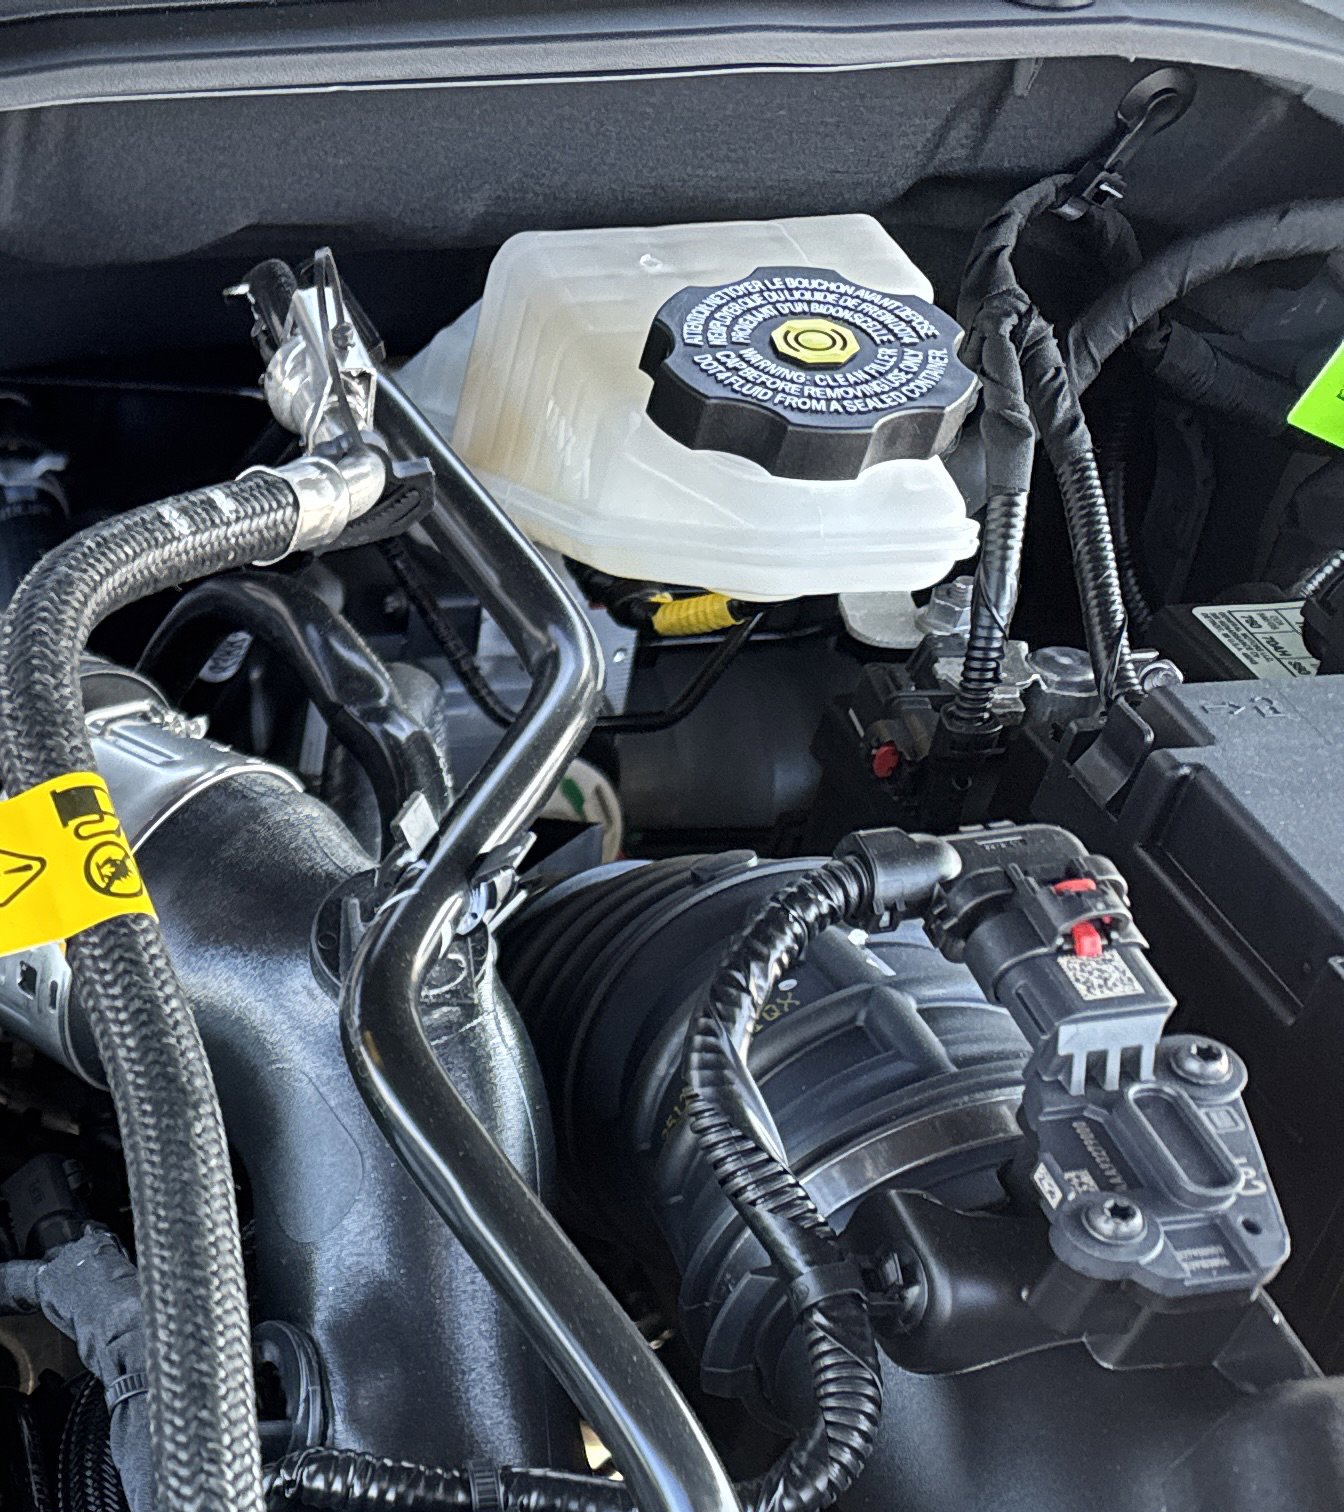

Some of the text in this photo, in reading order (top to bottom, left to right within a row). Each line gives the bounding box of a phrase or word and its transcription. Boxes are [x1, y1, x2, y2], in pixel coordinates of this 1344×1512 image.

[764, 278, 786, 290] LE
[785, 277, 855, 295] BOUCHON
[853, 288, 903, 311] AVANT
[785, 289, 841, 303] LIQUIDE
[840, 295, 860, 310] DE
[715, 350, 748, 370] CAP
[738, 369, 803, 395] BEFORE
[814, 369, 871, 387] CLEAN
[724, 375, 774, 400] FLUID
[773, 392, 828, 412] FROM
[830, 399, 844, 412] A
[842, 391, 908, 413] SEALED
